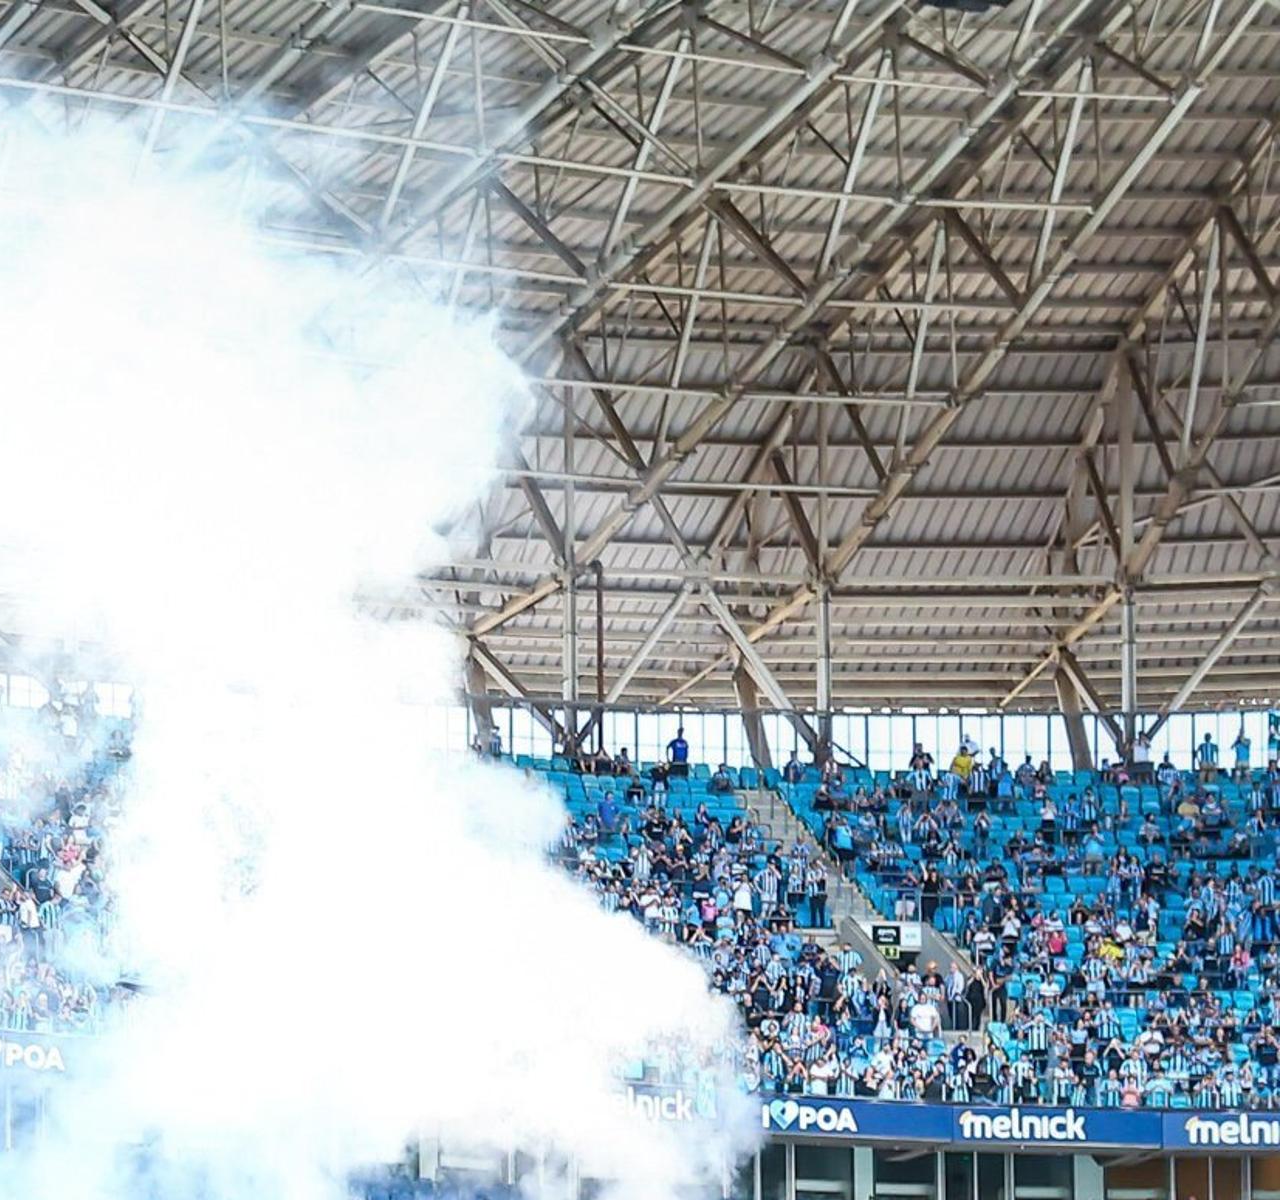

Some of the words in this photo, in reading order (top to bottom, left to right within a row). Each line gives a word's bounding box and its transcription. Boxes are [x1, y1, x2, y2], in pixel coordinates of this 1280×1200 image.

[5, 1040, 65, 1072] POA
[799, 1104, 858, 1133] POA
[959, 1107, 1086, 1142] melnick
[1185, 1113, 1280, 1145] melni
